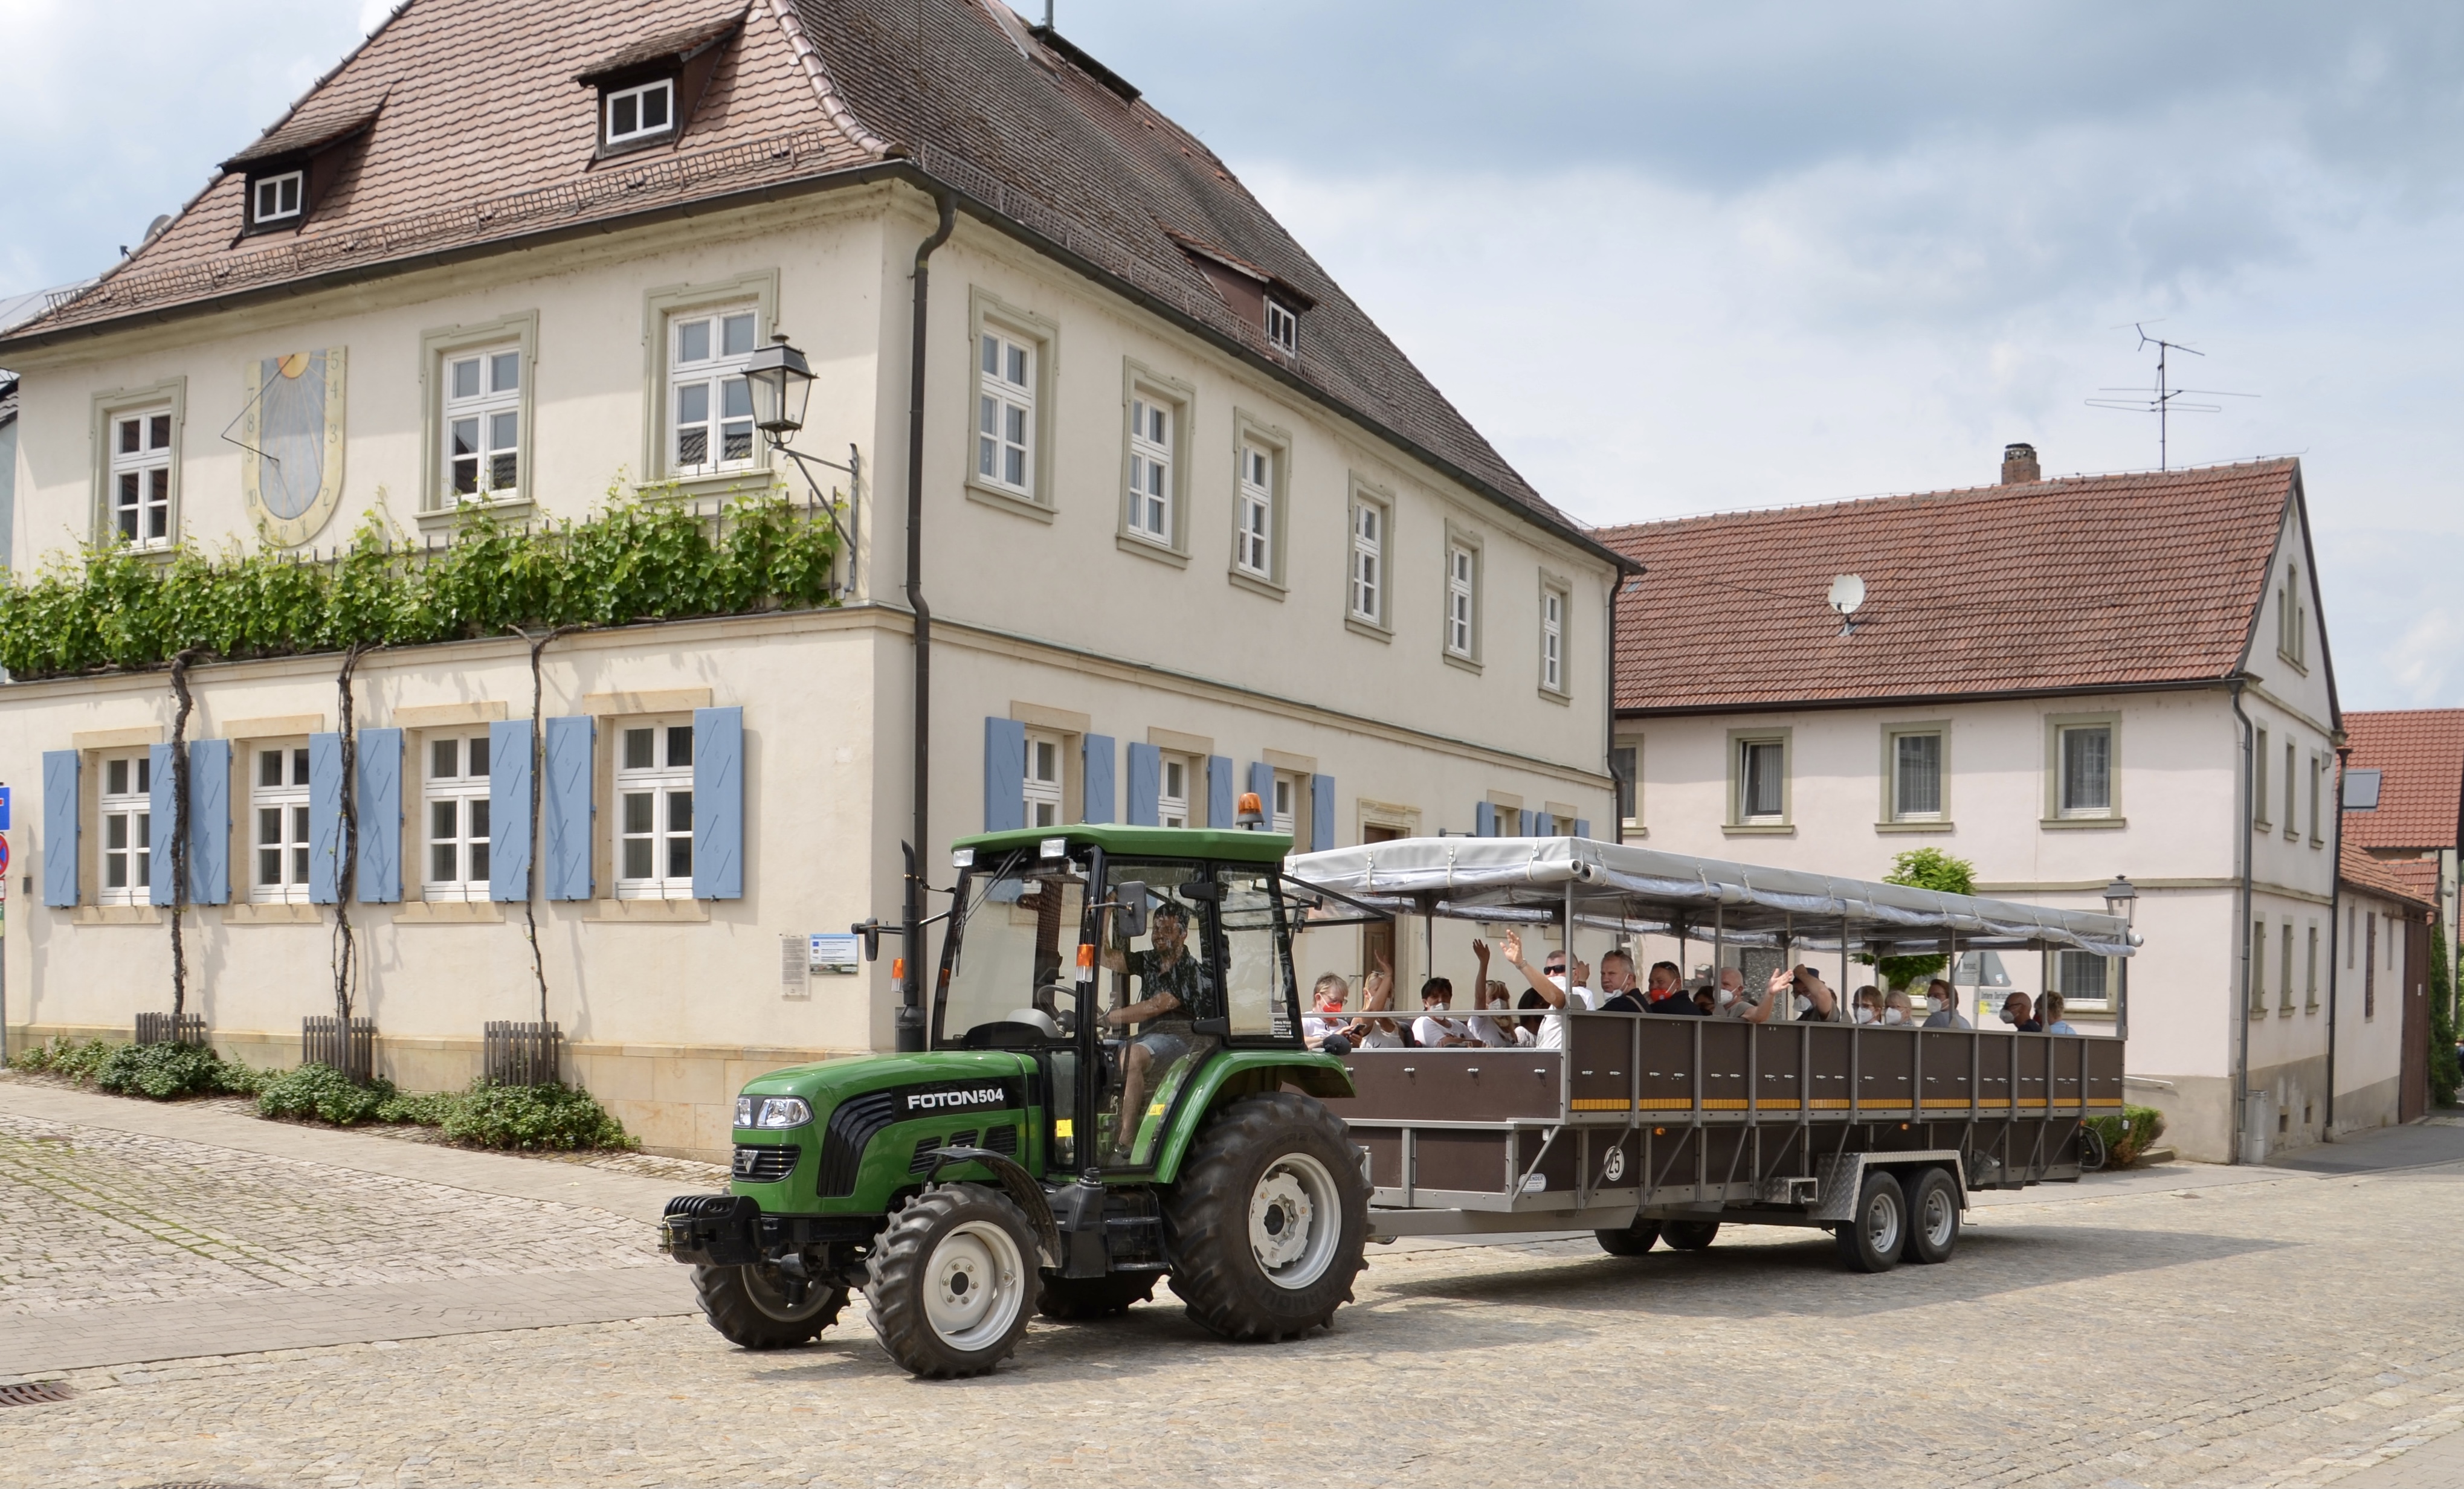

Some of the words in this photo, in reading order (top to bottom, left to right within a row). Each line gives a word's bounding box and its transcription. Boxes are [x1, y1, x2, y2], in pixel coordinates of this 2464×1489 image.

[331, 350, 339, 370] 5
[331, 380, 338, 399] 4
[247, 413, 254, 433] 8
[329, 423, 337, 443] 3
[248, 489, 257, 507] 10
[323, 487, 330, 507] 2
